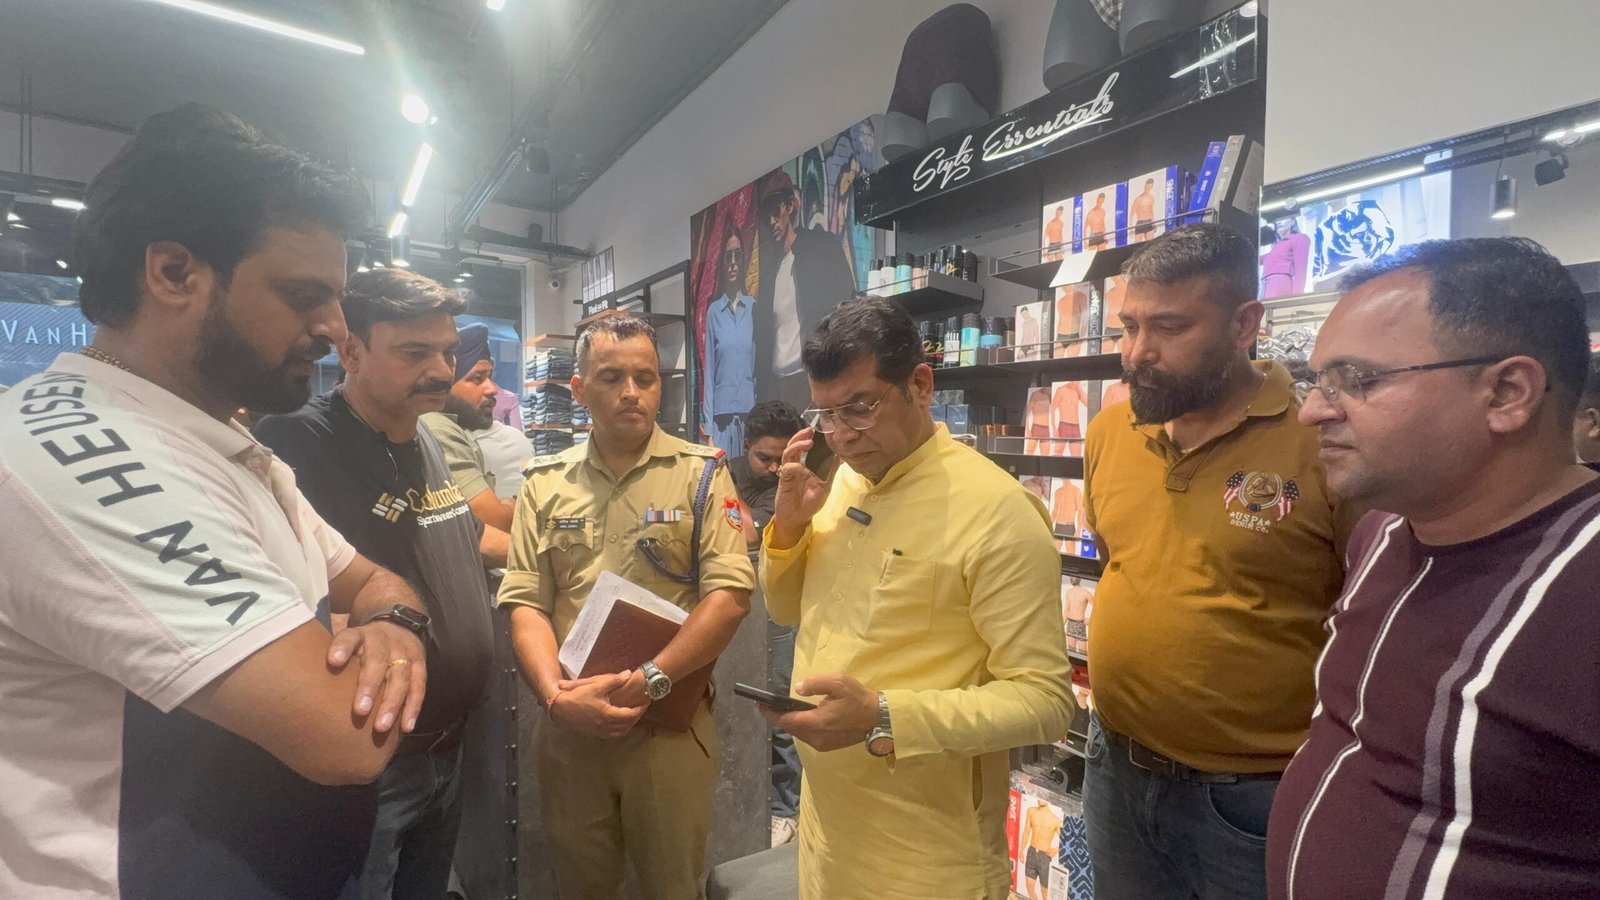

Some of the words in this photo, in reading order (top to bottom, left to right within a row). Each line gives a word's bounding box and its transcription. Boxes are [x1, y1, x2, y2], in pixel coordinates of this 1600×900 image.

[913, 134, 974, 192] Style
[982, 71, 1120, 160] Essentials
[20, 371, 164, 507] HEUSEN
[135, 520, 260, 626] VAN
